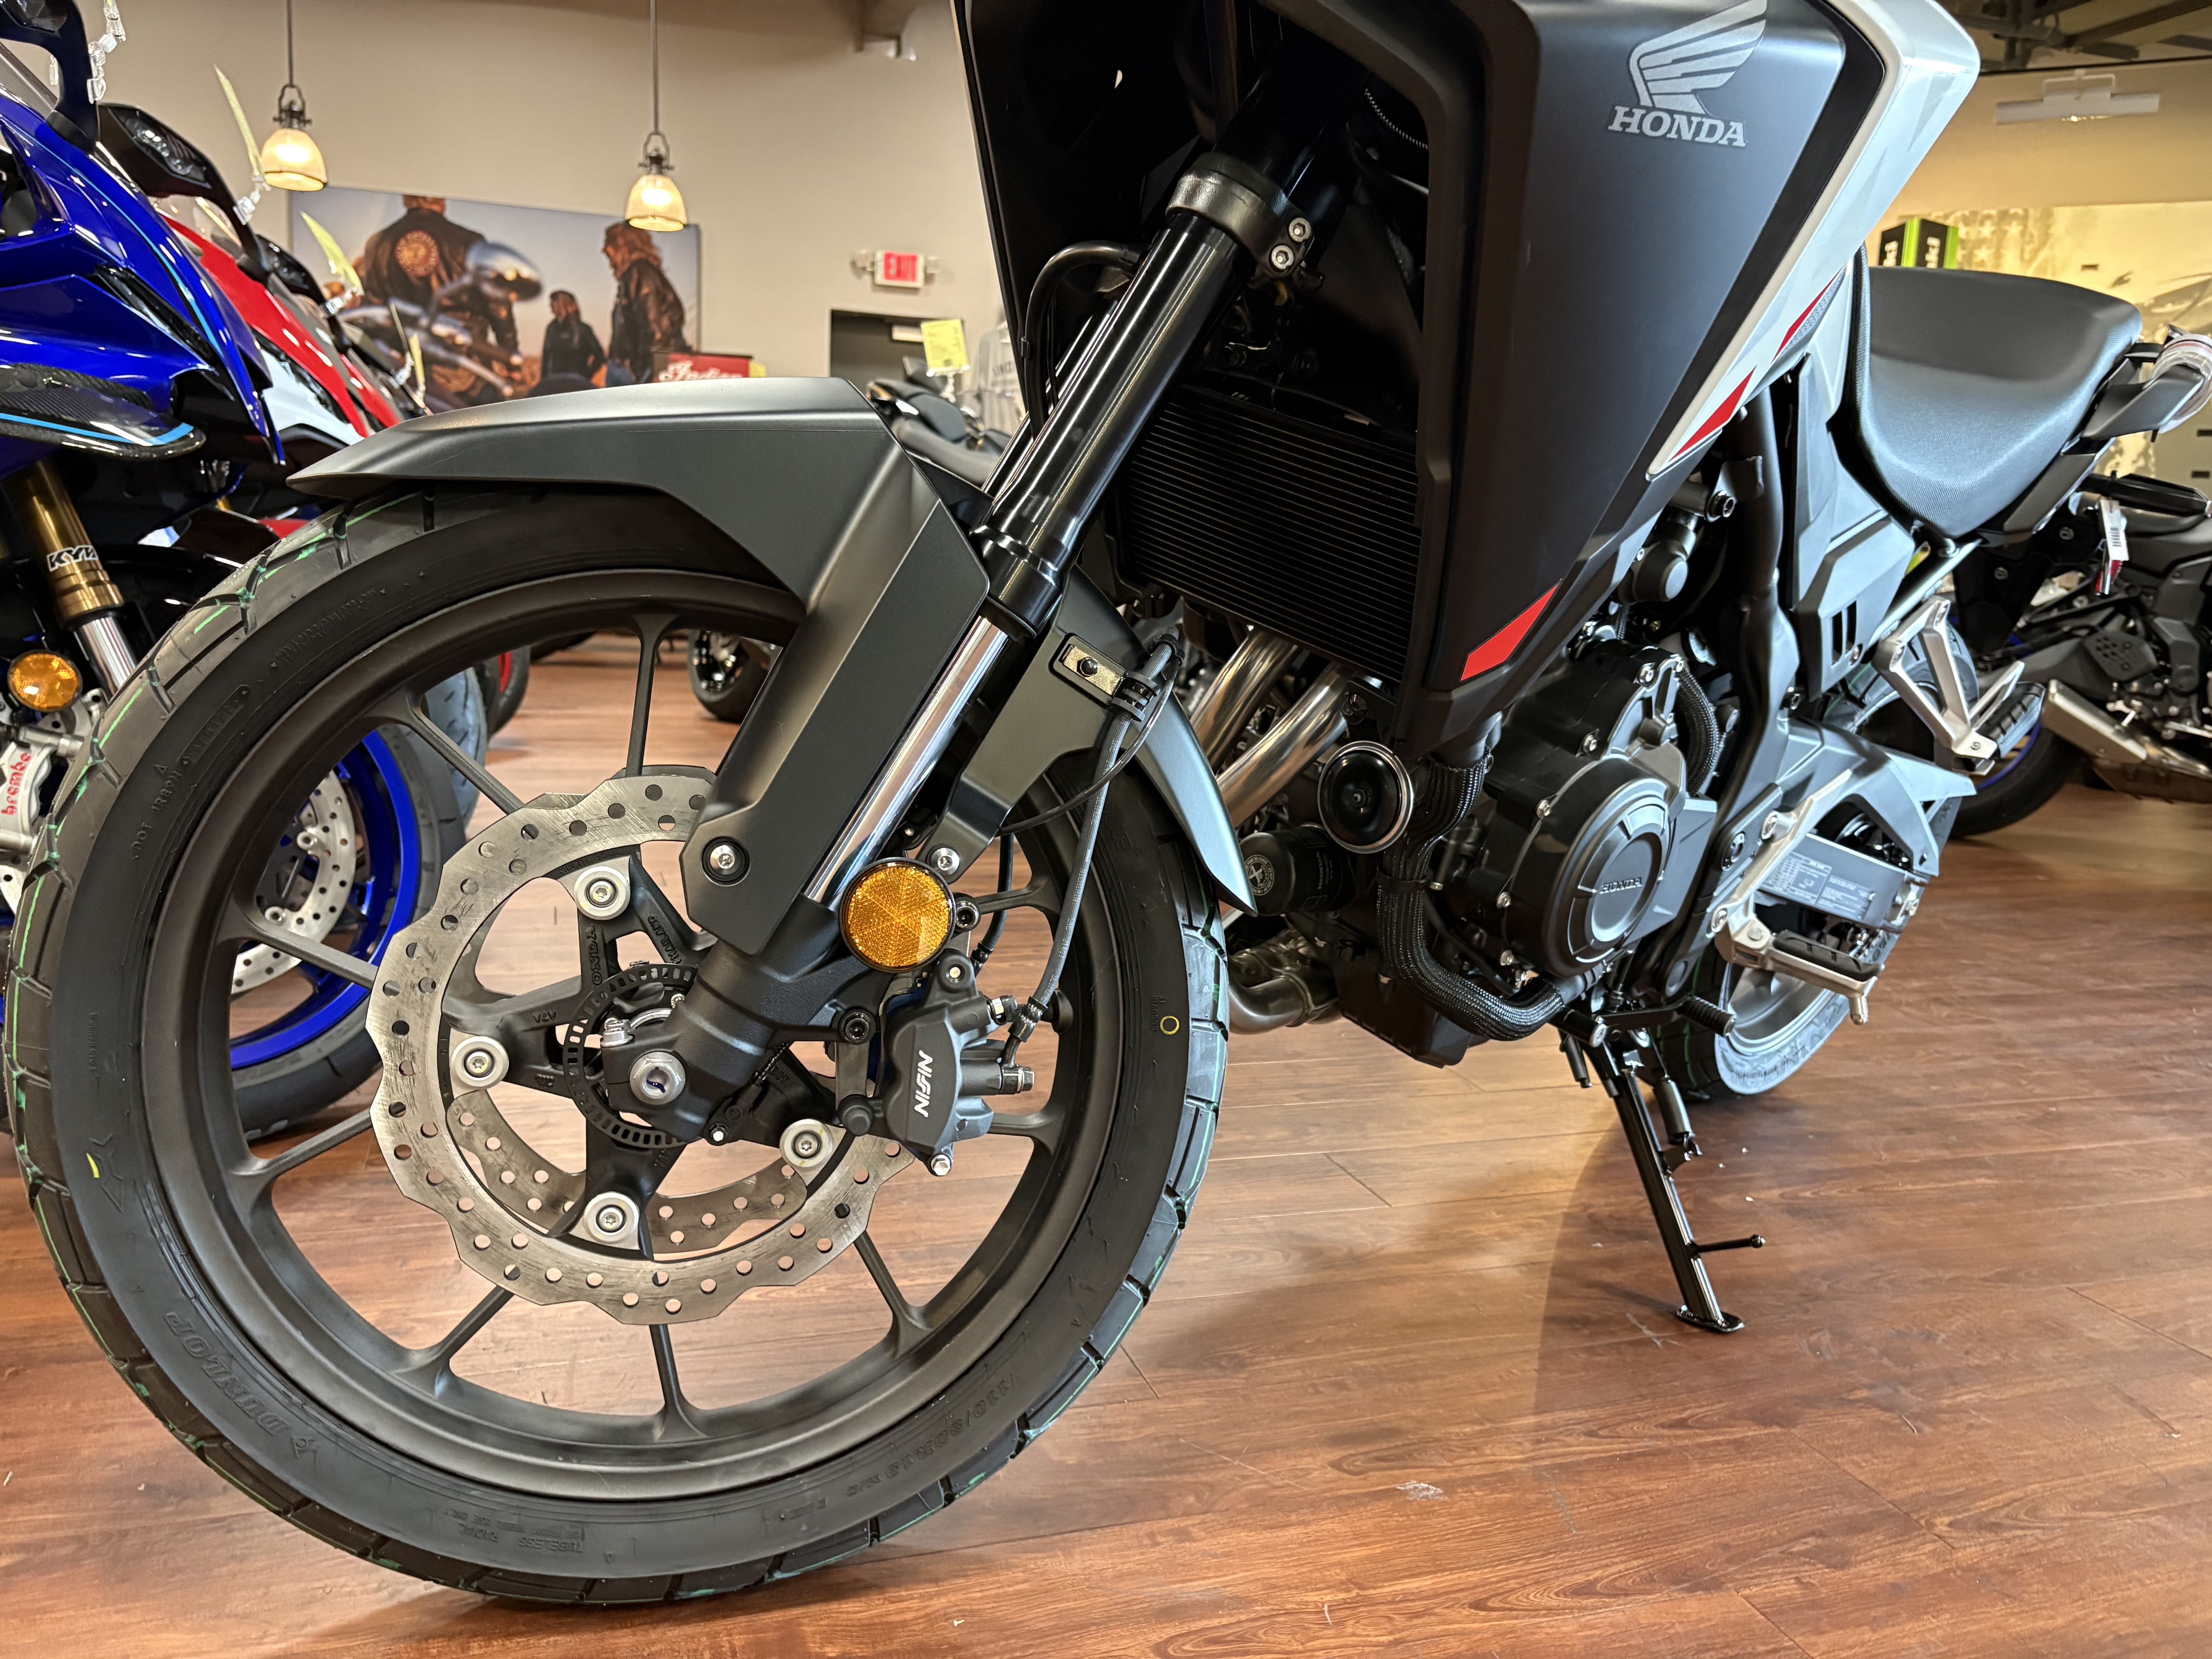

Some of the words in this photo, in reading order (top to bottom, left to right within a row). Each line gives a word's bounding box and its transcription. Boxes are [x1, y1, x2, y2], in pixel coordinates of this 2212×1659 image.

[1608, 106, 1746, 147] HONDA
[1, 752, 32, 816] brembo
[1599, 877, 1643, 894] HONDA
[585, 924, 603, 986] ONDA
[648, 915, 682, 964] THAILAND
[164, 1311, 290, 1436] DUNLOP
[518, 1536, 584, 1553] TUBELESS
